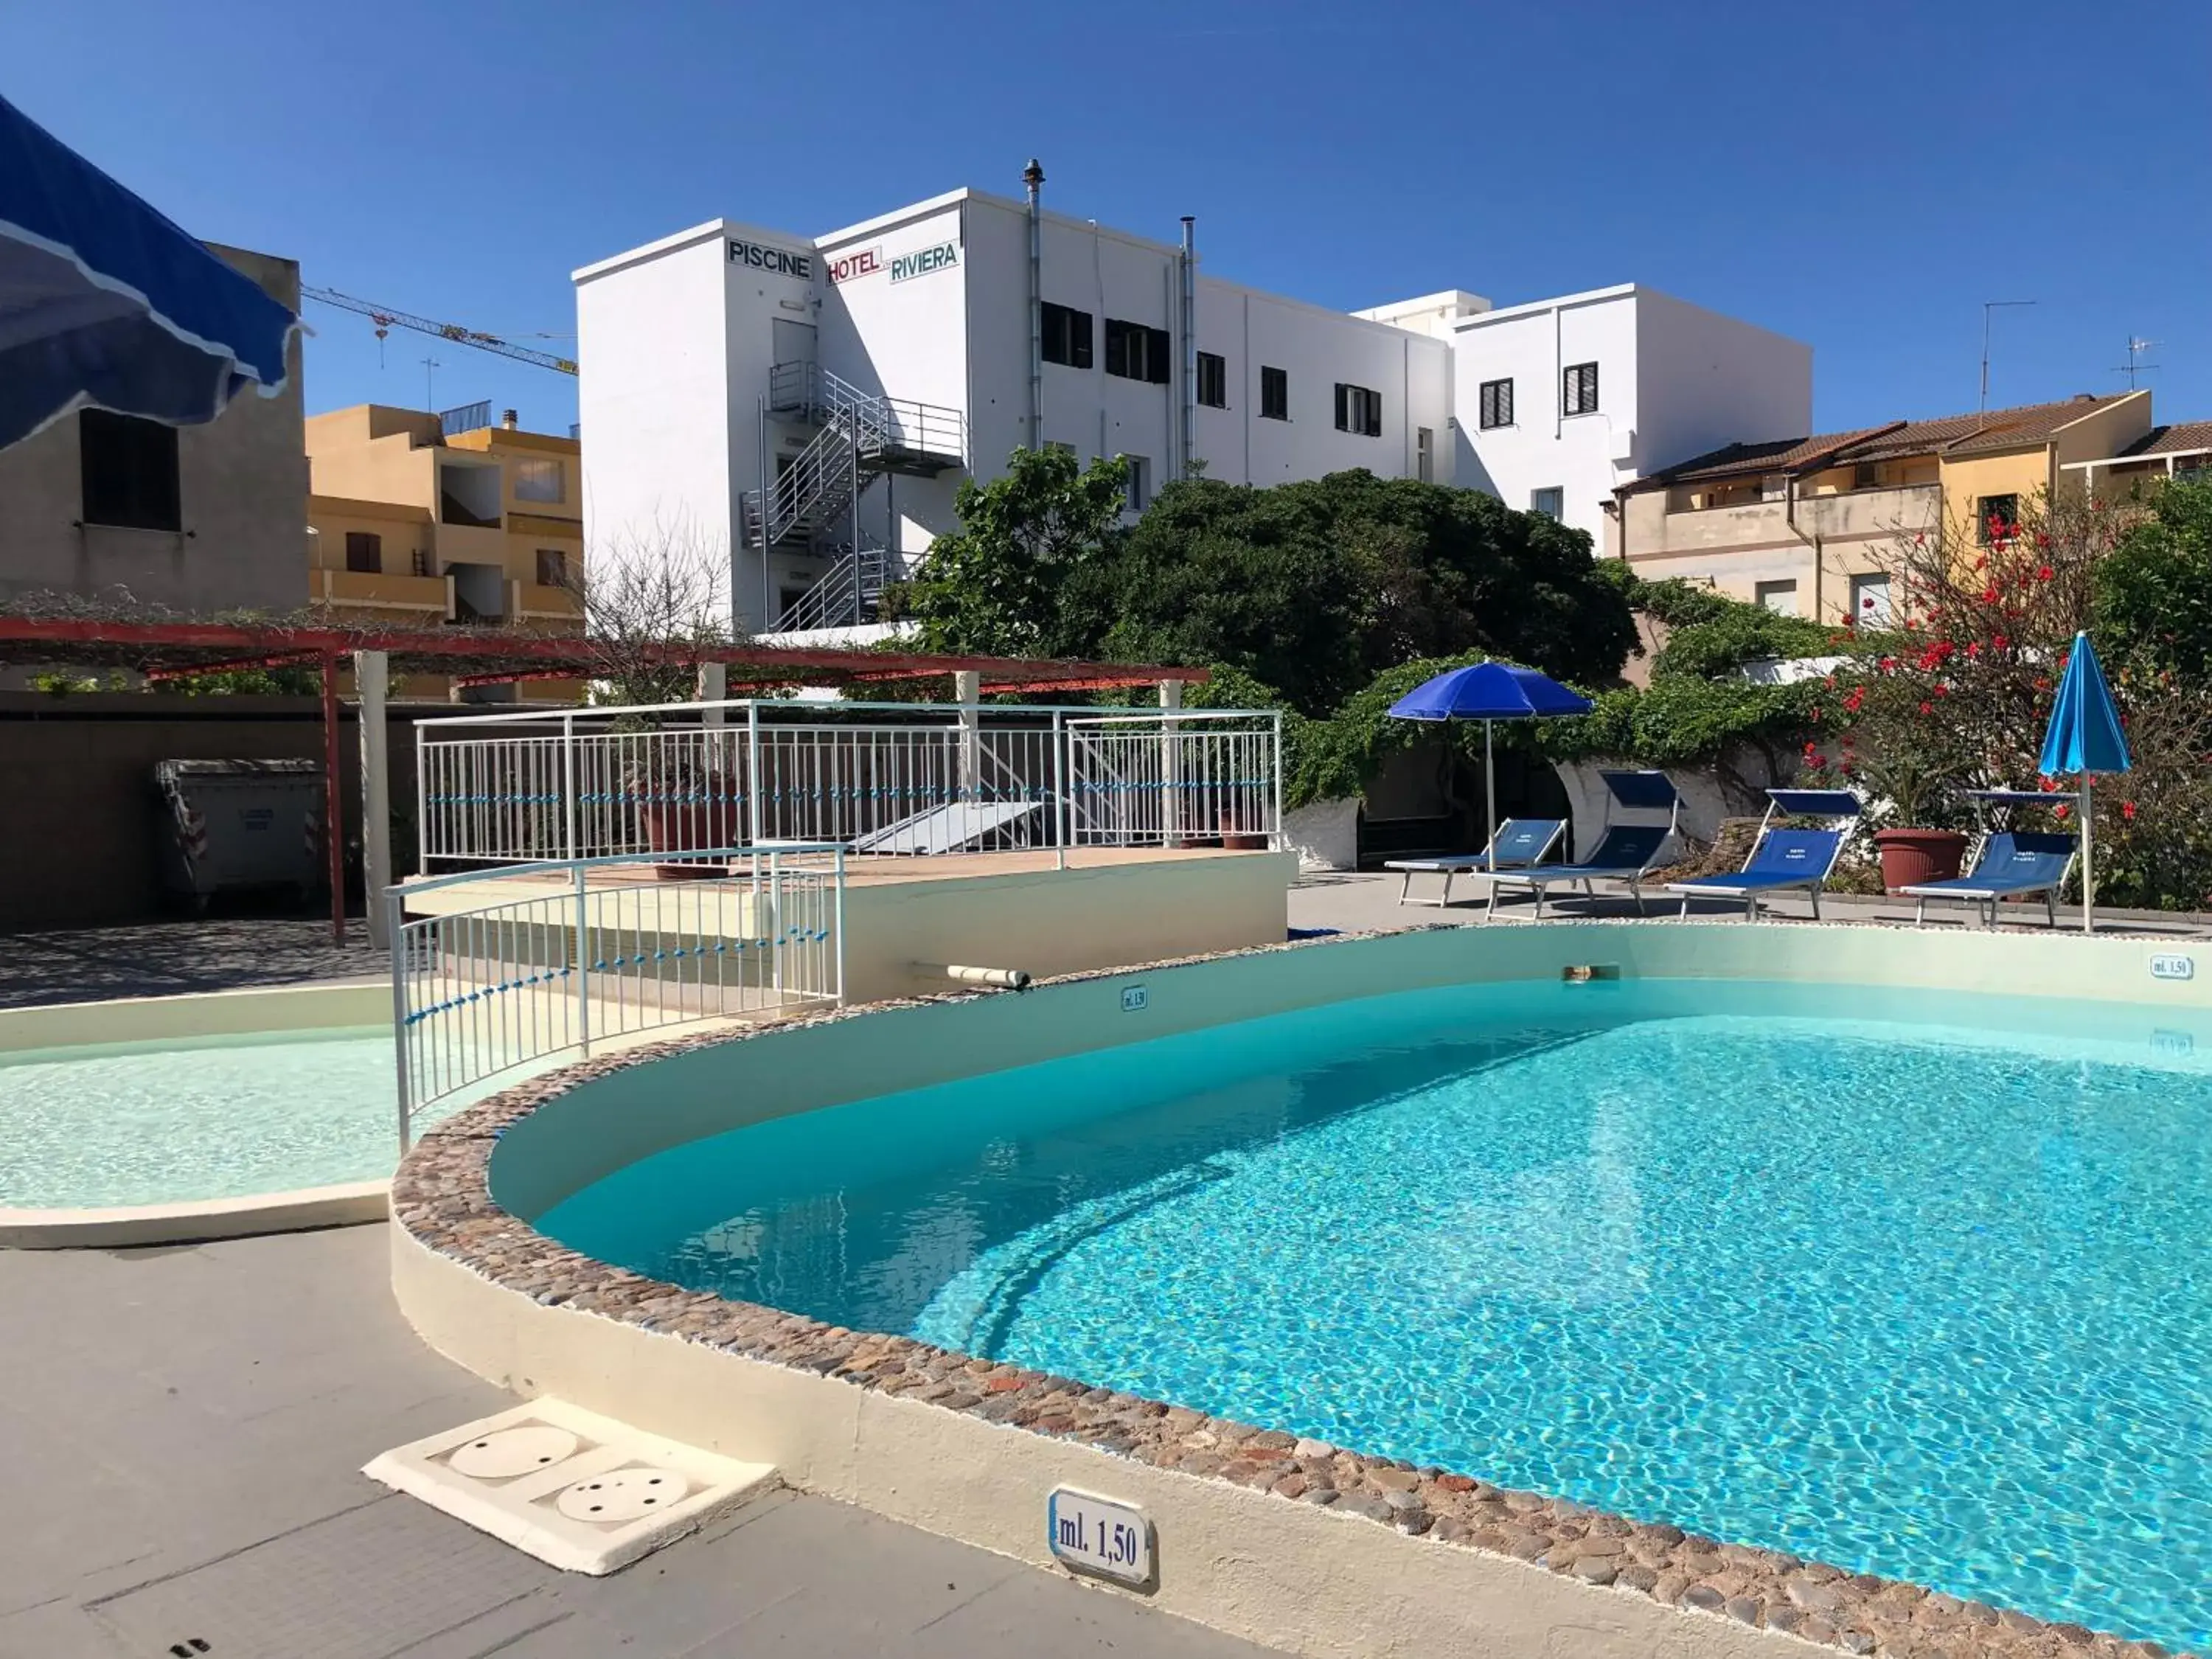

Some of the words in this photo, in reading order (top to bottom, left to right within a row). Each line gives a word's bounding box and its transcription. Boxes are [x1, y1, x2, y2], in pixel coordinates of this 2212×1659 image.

[729, 240, 810, 278] PISCINE
[827, 251, 880, 284] HOTEL
[891, 243, 957, 280] RIVIERA
[1060, 1512, 1088, 1552] ml.
[1098, 1520, 1137, 1566] 1,50
